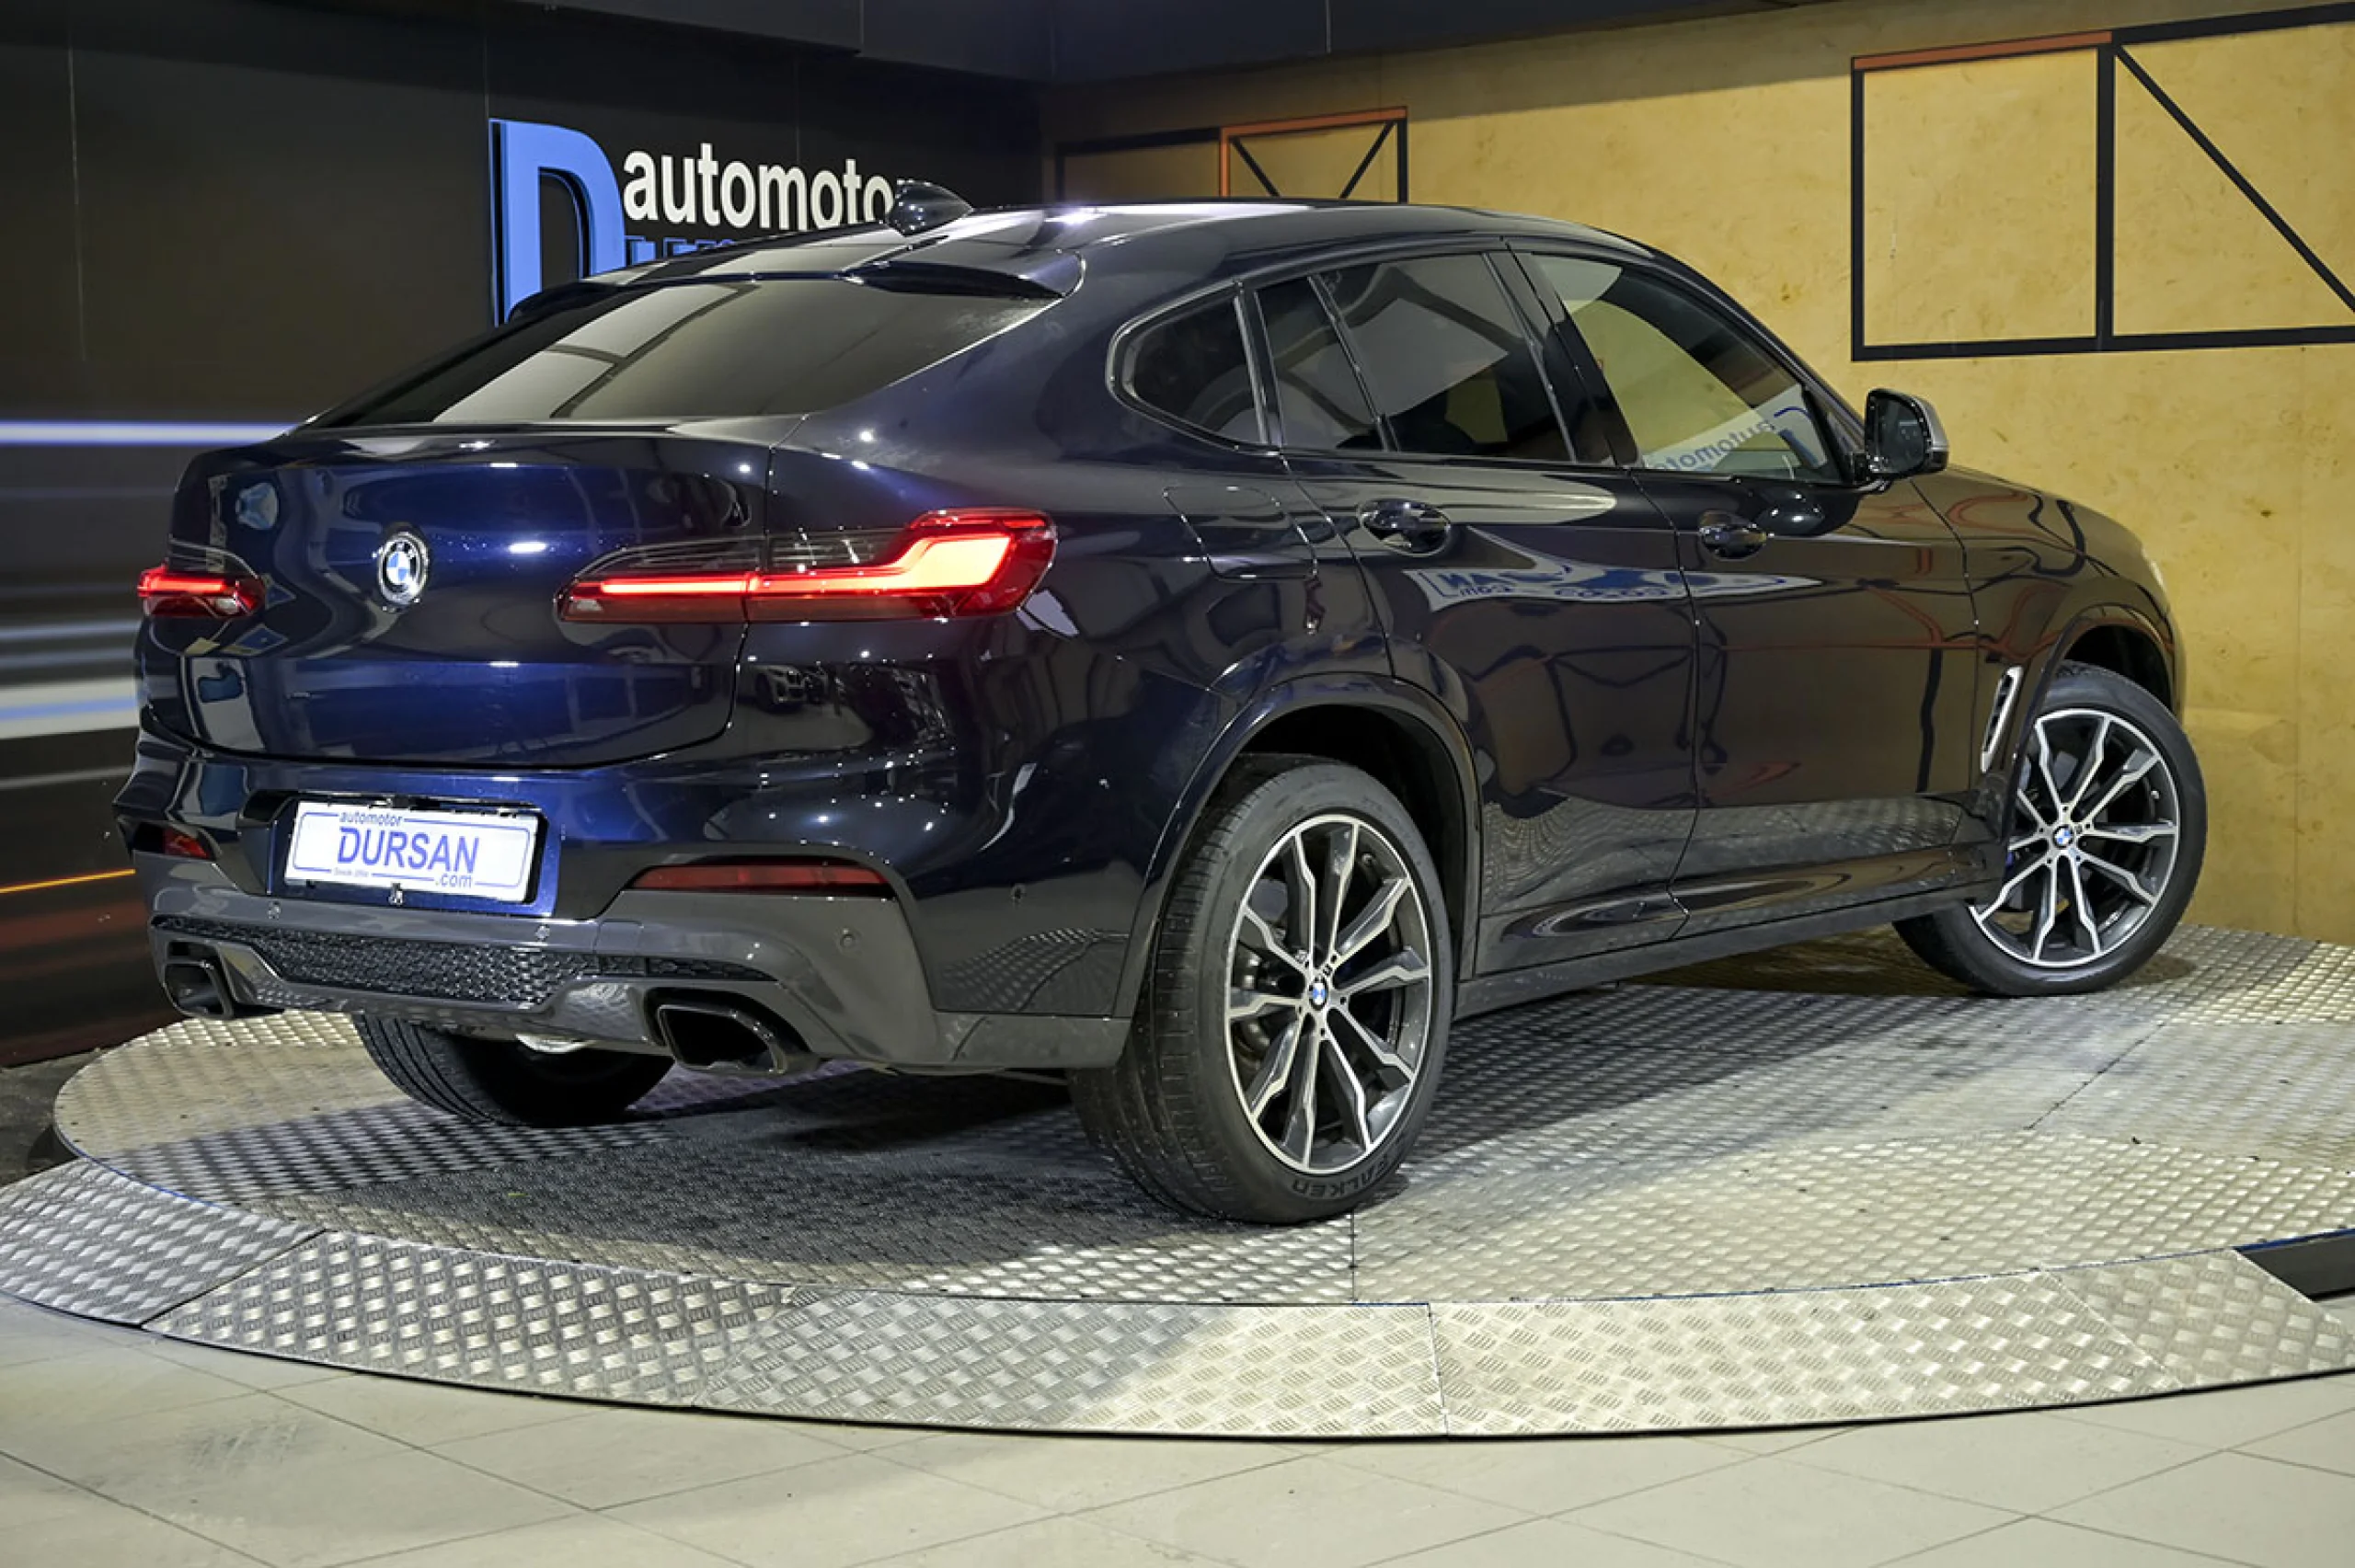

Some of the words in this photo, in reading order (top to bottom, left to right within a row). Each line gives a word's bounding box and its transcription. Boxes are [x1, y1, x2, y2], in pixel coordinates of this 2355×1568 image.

[623, 143, 903, 231] automoto
[339, 810, 403, 827] automotor
[337, 826, 479, 874] DURSAN
[435, 874, 472, 888] .com
